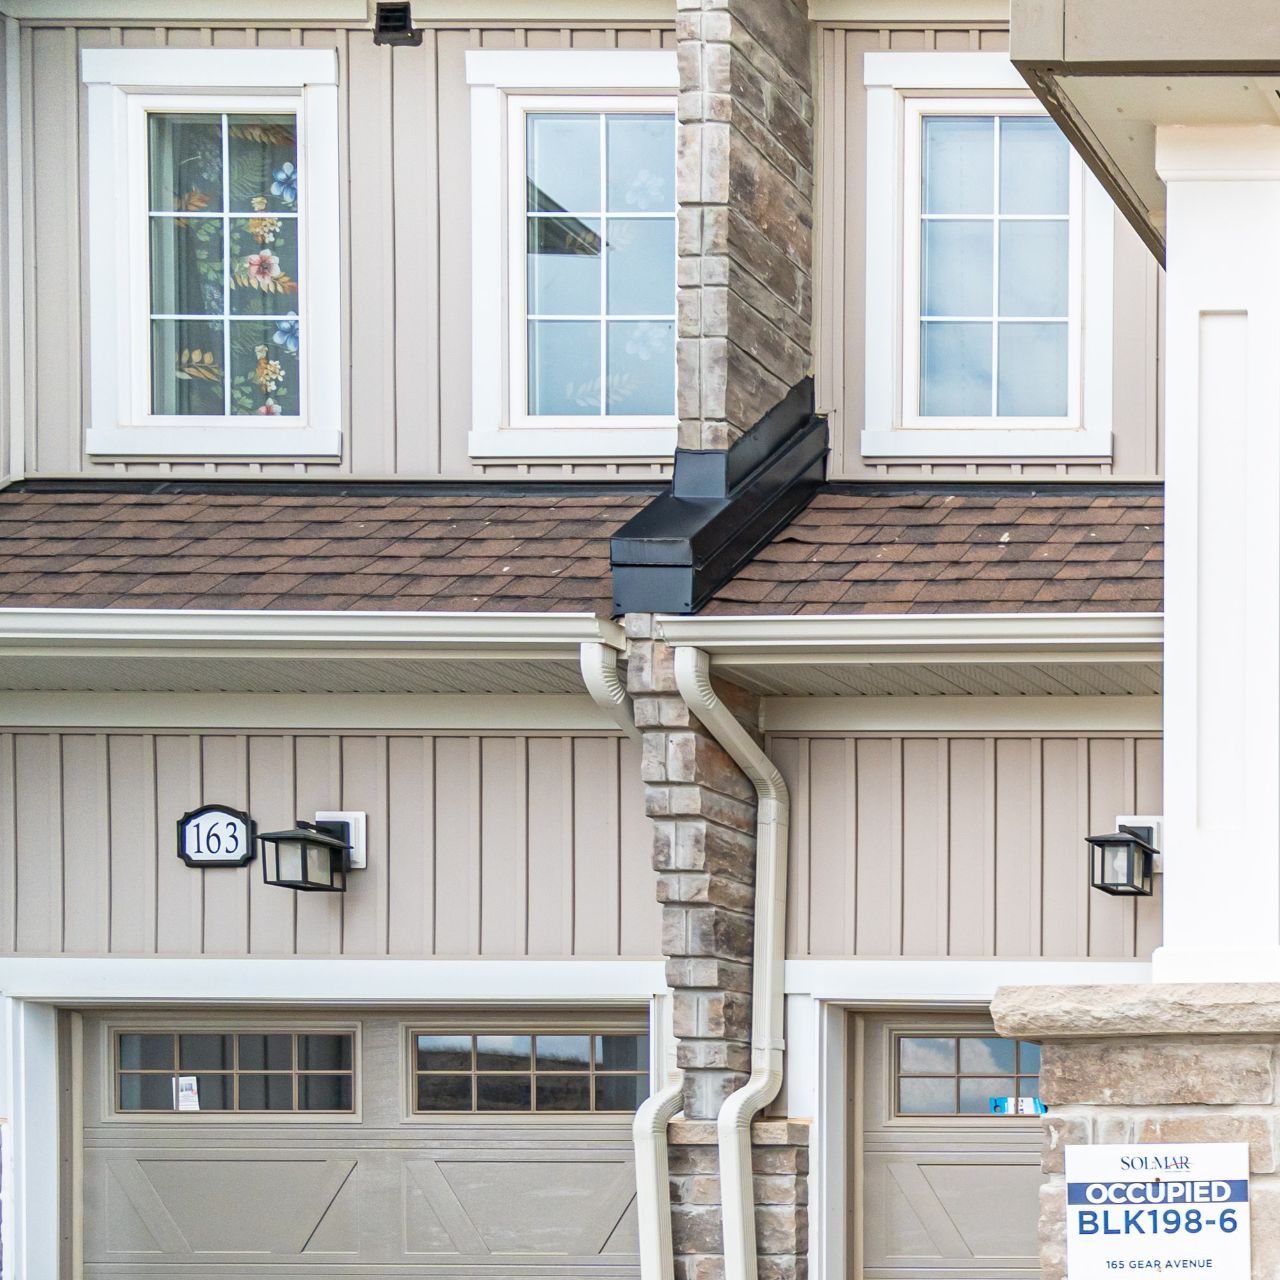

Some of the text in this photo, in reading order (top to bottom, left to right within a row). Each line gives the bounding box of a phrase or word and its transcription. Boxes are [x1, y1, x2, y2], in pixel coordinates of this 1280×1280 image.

[193, 821, 239, 854] 163
[1120, 1155, 1191, 1170] SOLMAR
[1085, 1181, 1232, 1204] OCCUPIED
[1078, 1208, 1238, 1235] BLK198-6
[1106, 1259, 1213, 1269] 165 GEAR AVENUE
